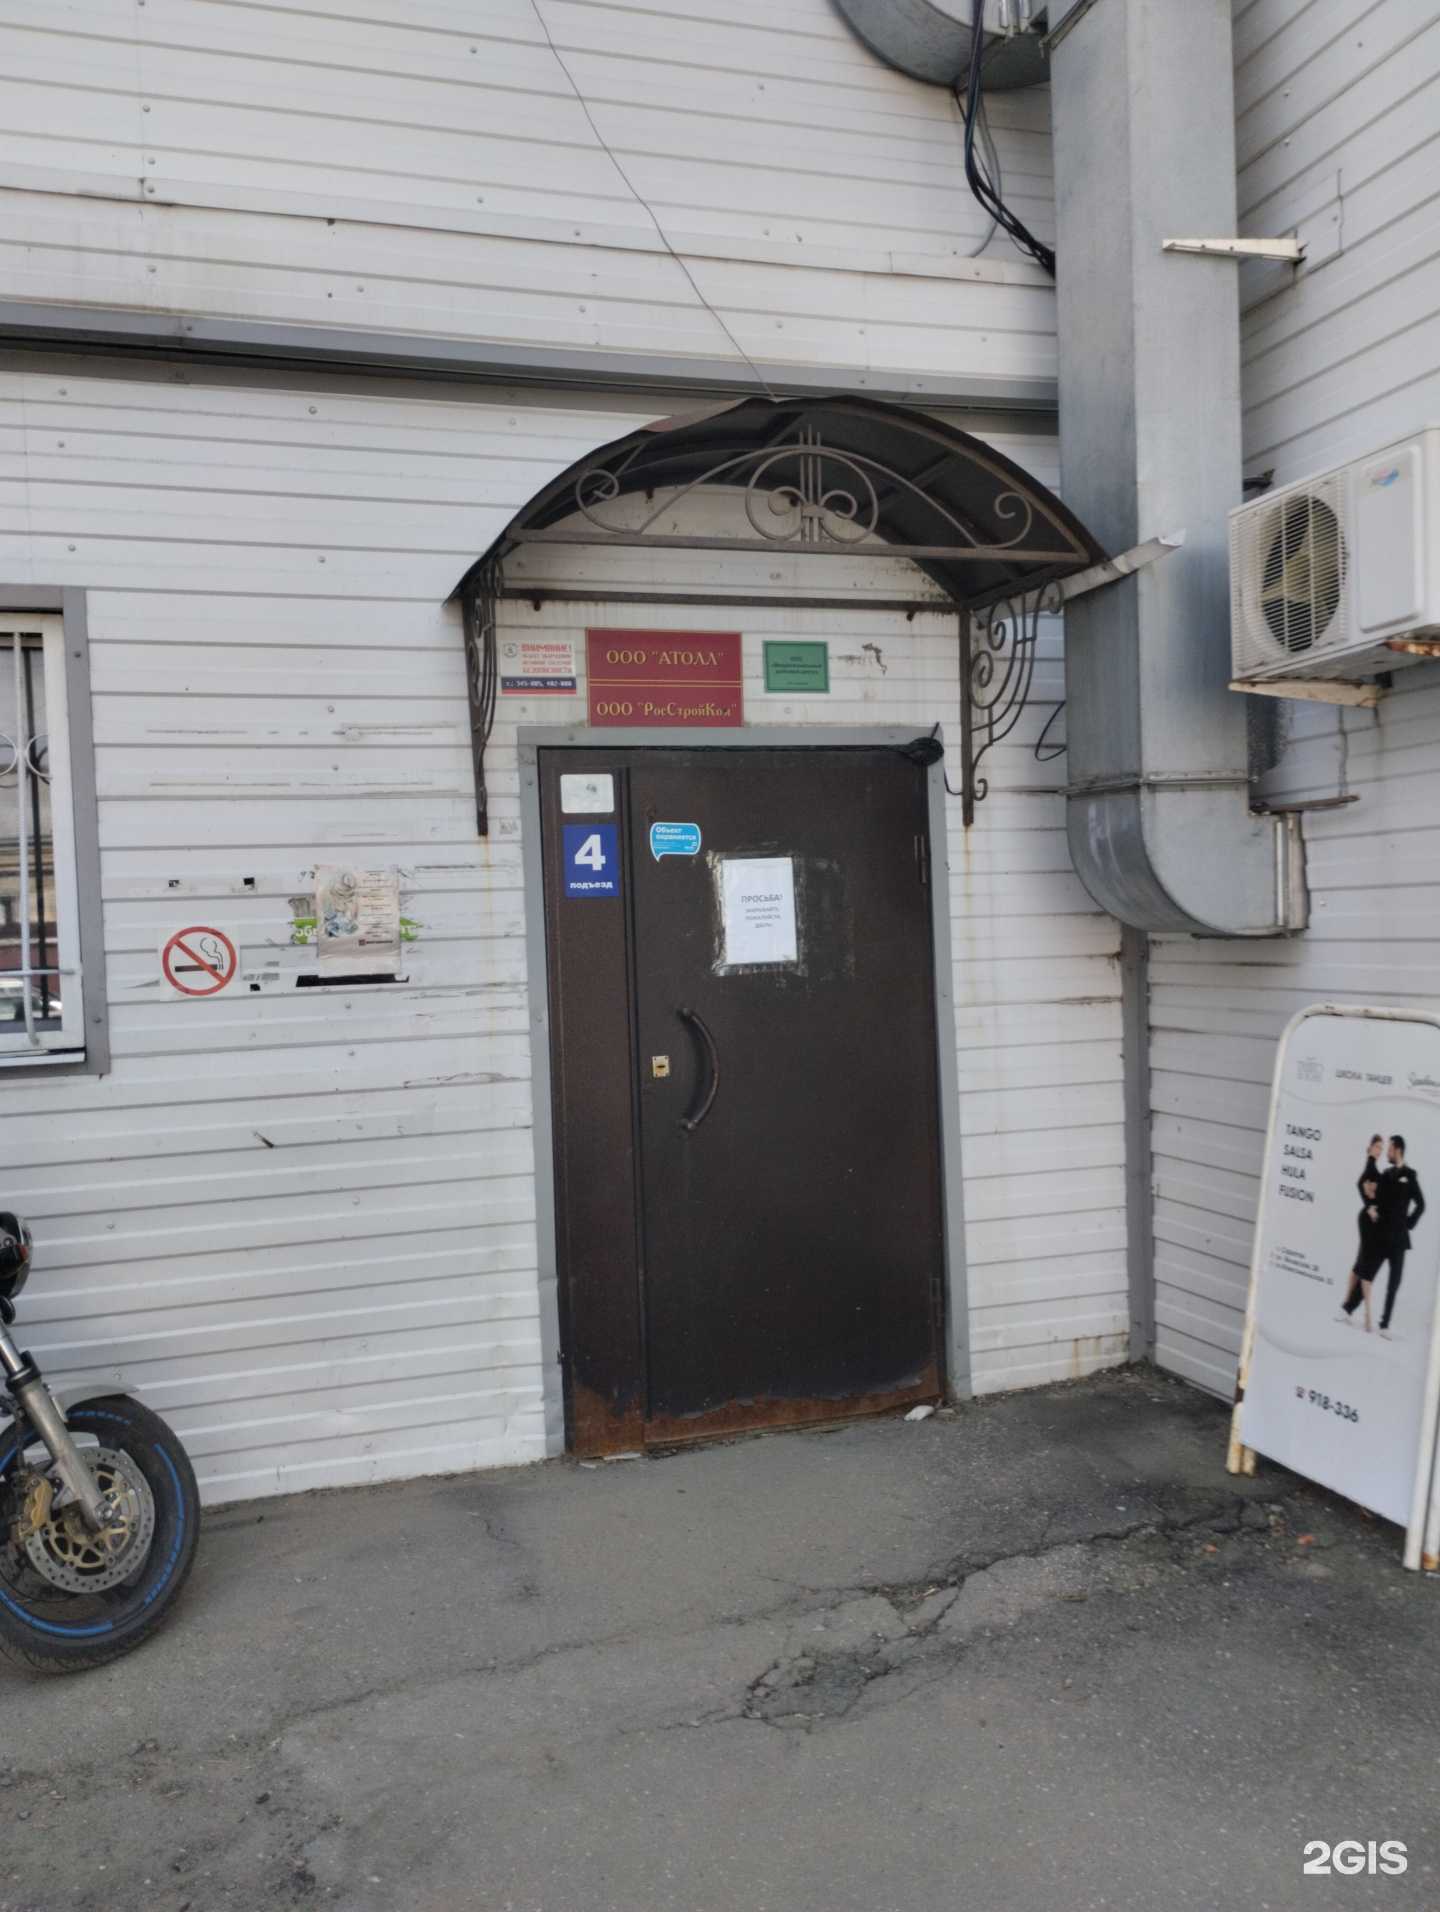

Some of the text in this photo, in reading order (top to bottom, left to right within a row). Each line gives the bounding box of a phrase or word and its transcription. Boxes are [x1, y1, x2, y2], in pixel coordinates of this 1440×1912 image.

[606, 649, 725, 666] ООО "АТОЛЛ"
[596, 702, 633, 717] ООО
[574, 834, 607, 871] 4
[570, 881, 613, 890] подъезд
[1286, 1123, 1322, 1142] TANGO
[1283, 1143, 1313, 1160] SALSA
[1278, 1183, 1315, 1203] FUSION
[1308, 1389, 1360, 1424] 918-336
